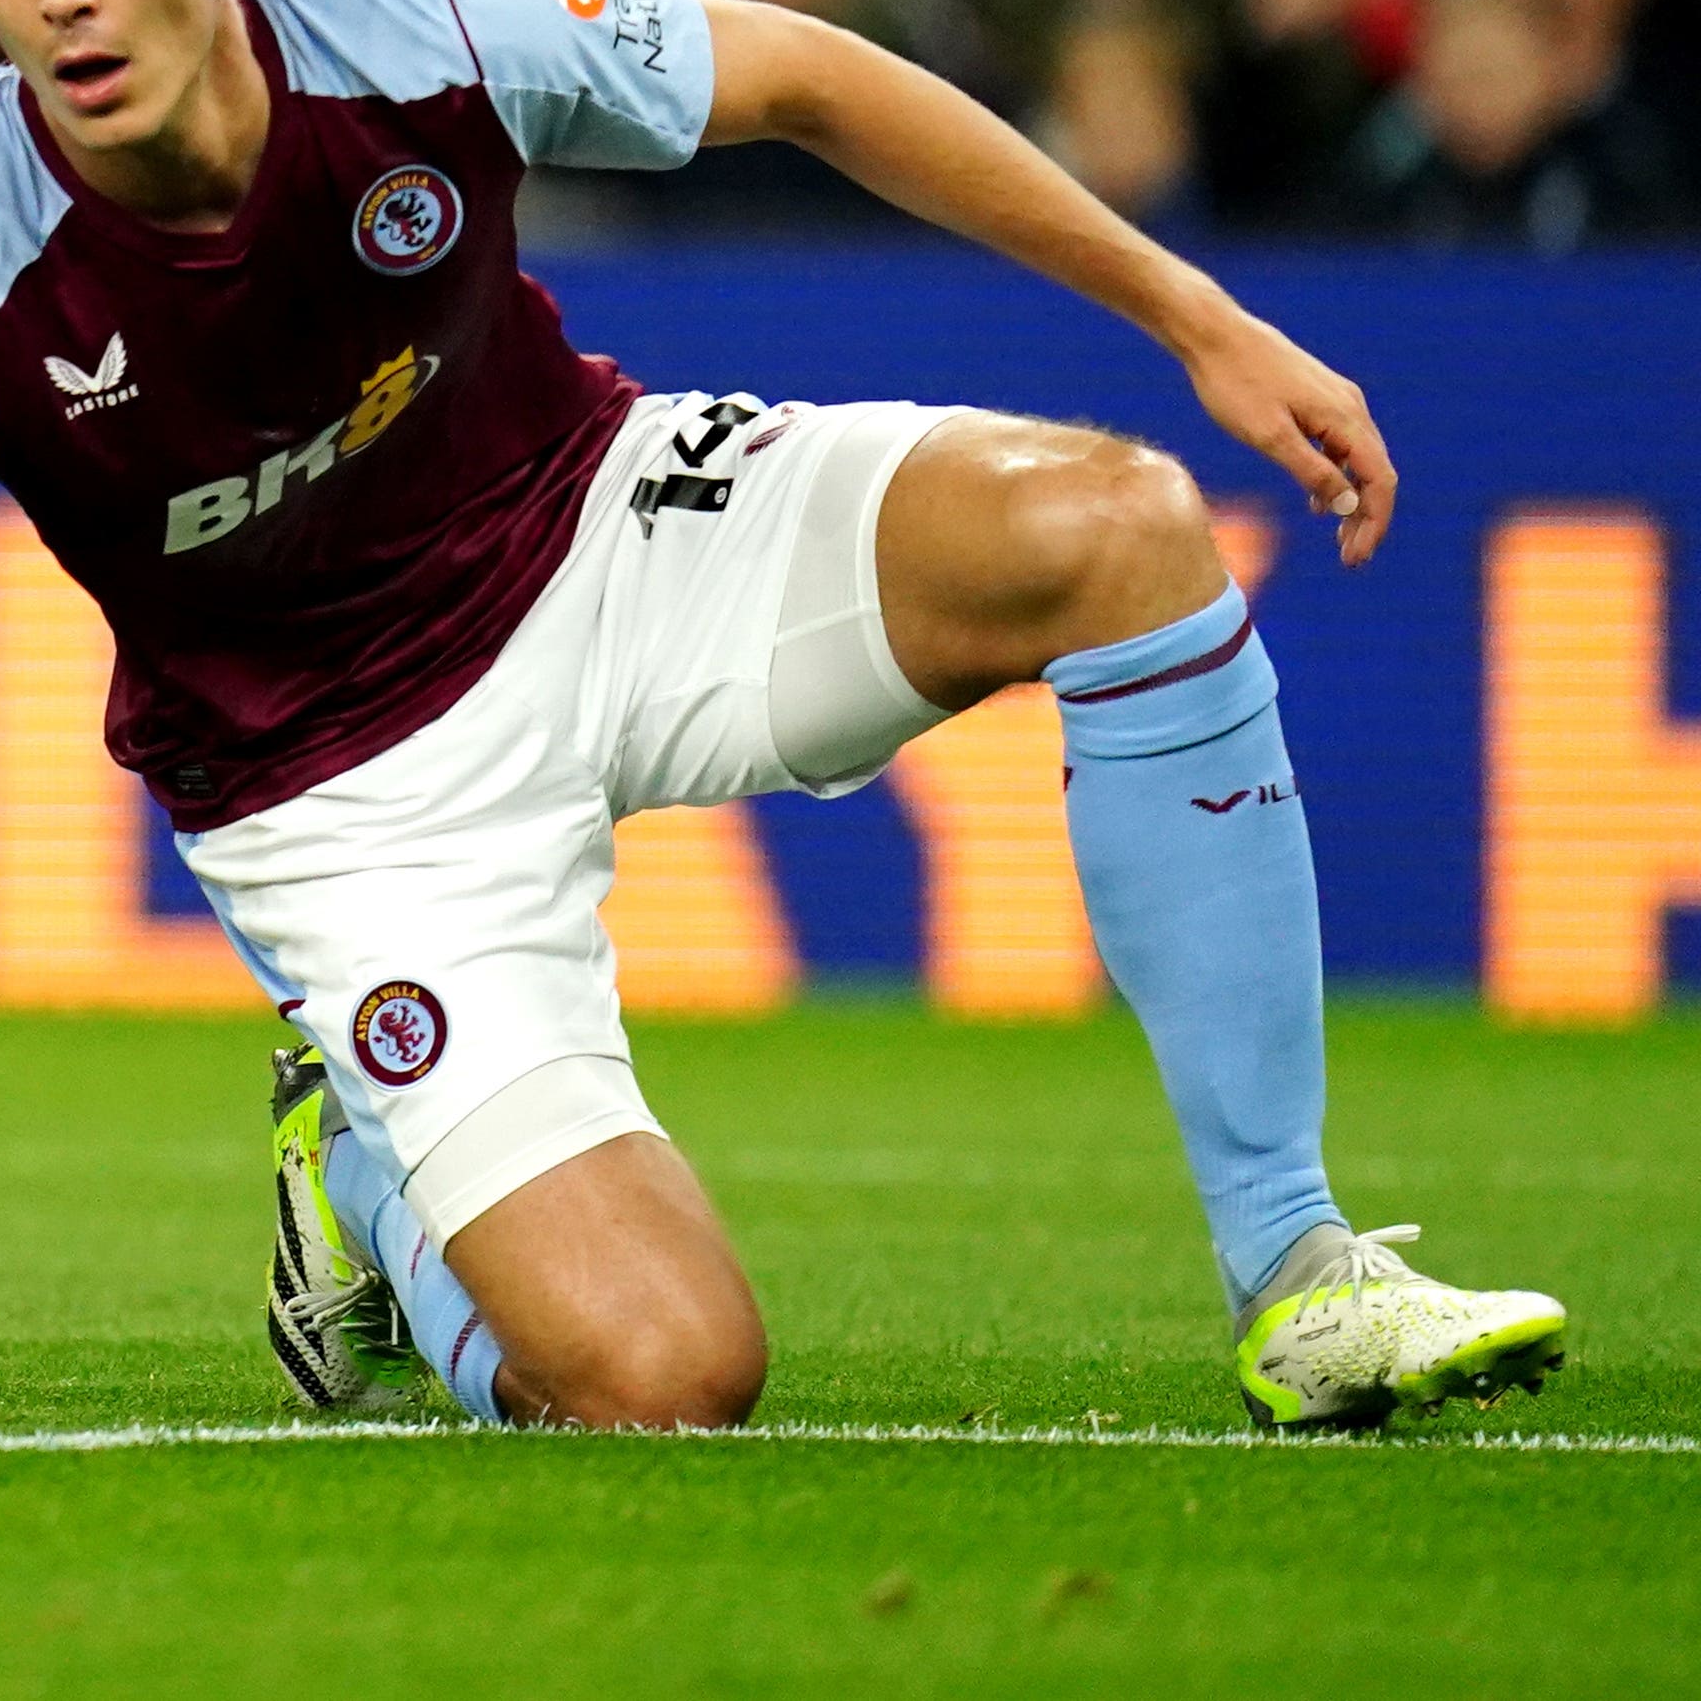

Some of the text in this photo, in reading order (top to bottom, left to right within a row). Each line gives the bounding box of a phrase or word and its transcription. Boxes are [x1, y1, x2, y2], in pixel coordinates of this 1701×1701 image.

[361, 175, 429, 229] ASTON VILLA
[162, 364, 419, 555] BK8
[356, 985, 420, 1041] ASTON VILLA
